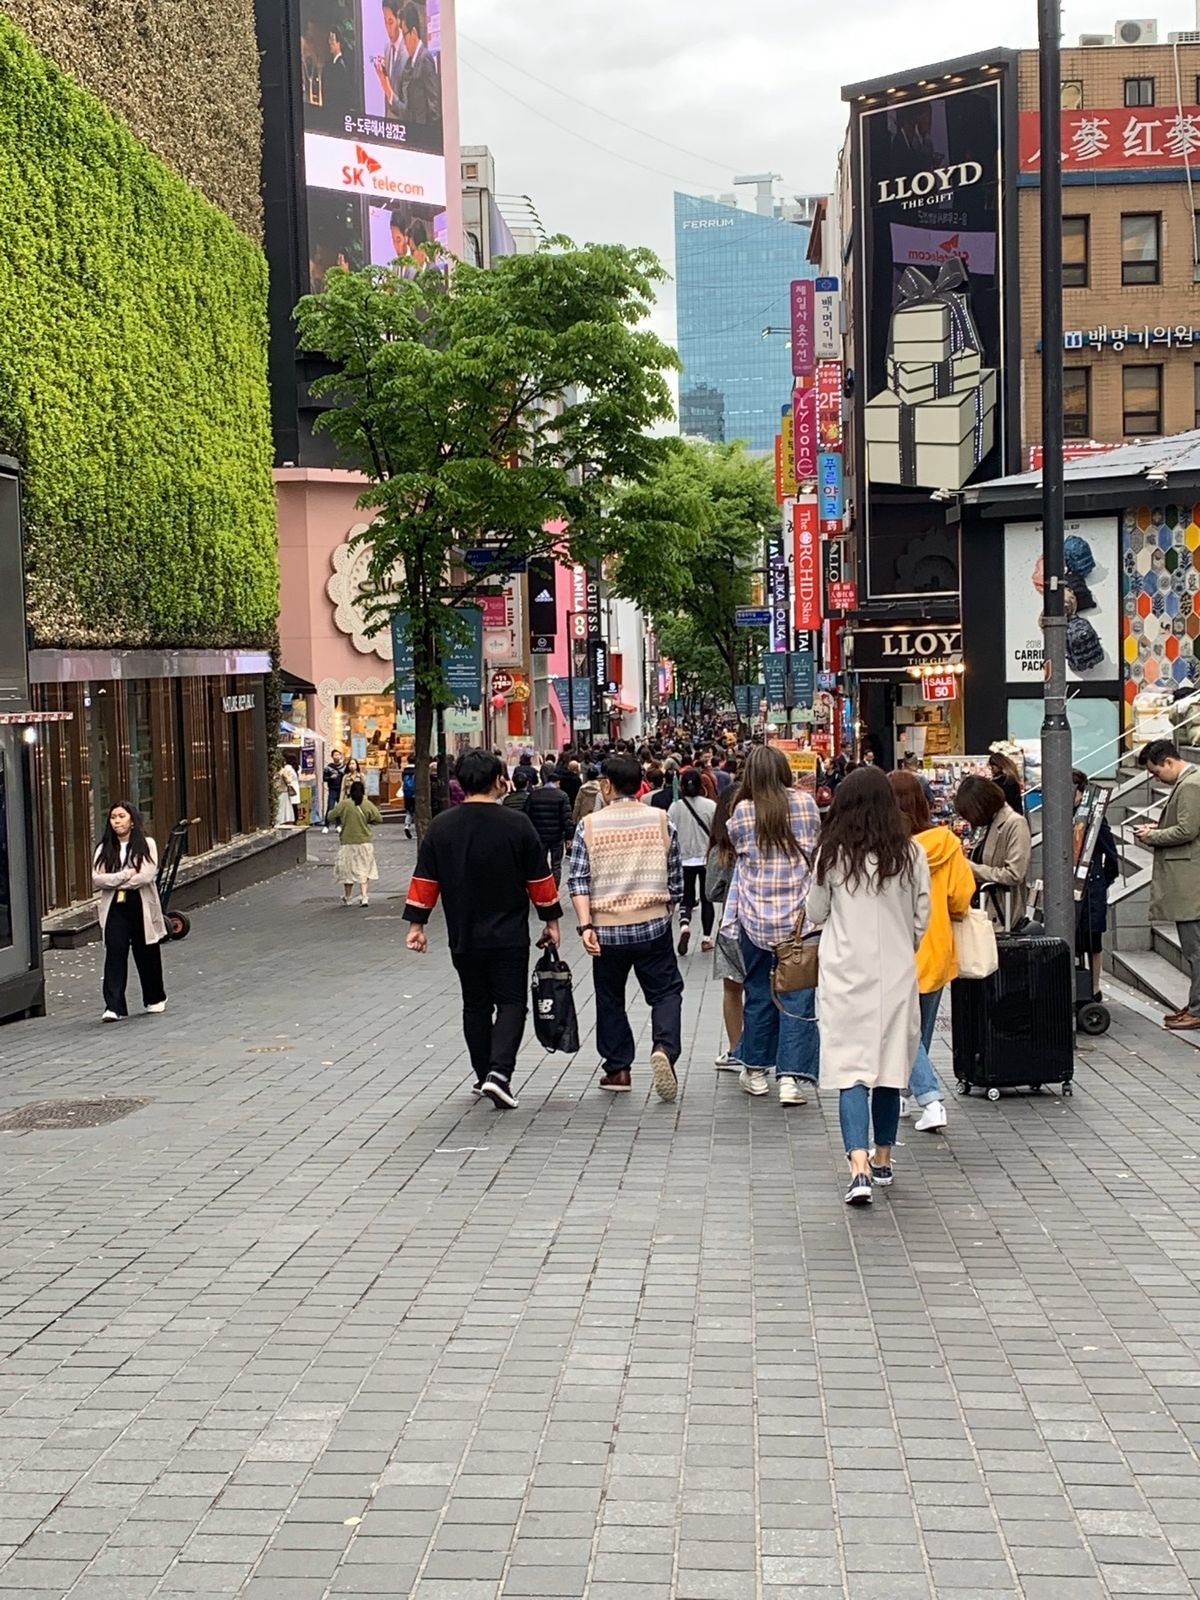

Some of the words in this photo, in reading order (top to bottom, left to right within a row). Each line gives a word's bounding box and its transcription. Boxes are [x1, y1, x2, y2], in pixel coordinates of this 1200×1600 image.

[342, 166, 365, 188] SK
[372, 175, 425, 197] telecom
[878, 161, 983, 203] LLOYD
[901, 198, 925, 210] THE
[926, 192, 954, 205] GIFT
[682, 218, 734, 230] FERRUM
[821, 295, 833, 340] 백명기
[1088, 324, 1193, 352] 백명기의원
[800, 509, 811, 531] The
[587, 583, 598, 632] GUESS
[574, 615, 585, 636] CO
[882, 632, 961, 656] LLOY
[1025, 640, 1042, 649] 2018
[929, 677, 952, 687] SALE
[934, 686, 949, 697] 50
